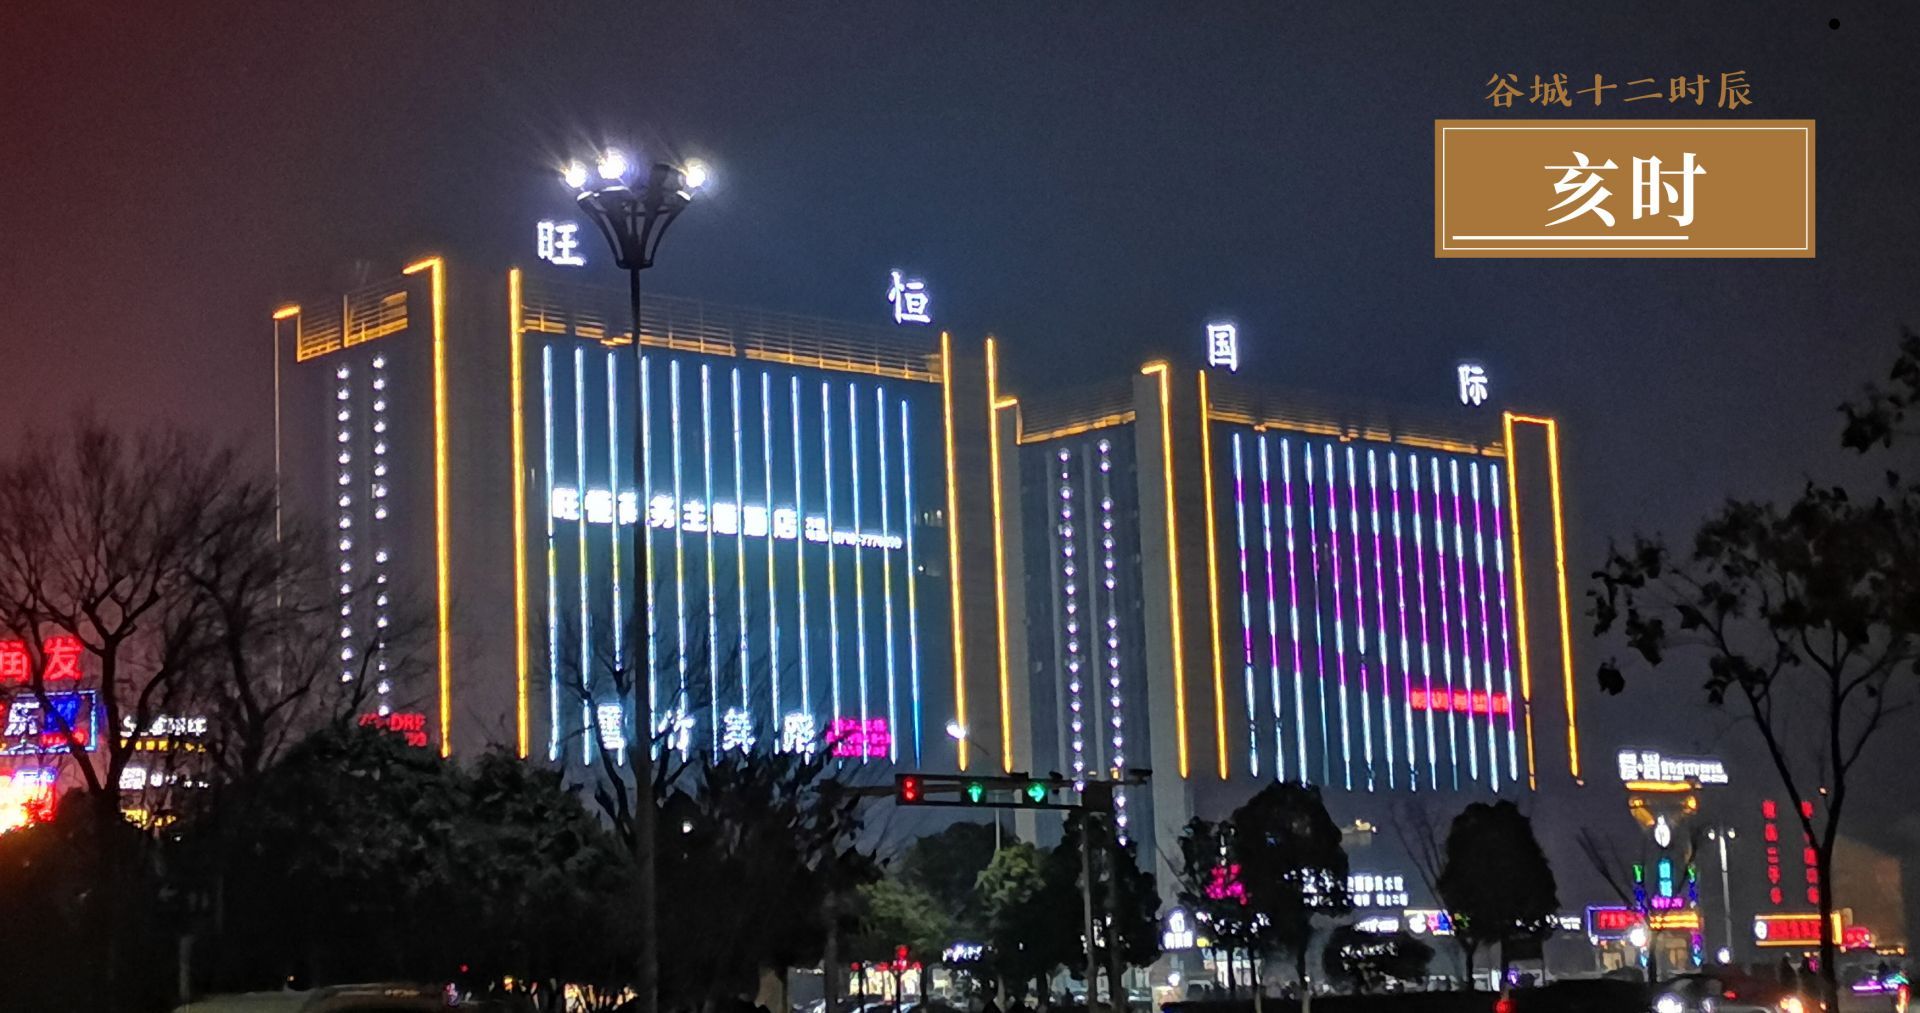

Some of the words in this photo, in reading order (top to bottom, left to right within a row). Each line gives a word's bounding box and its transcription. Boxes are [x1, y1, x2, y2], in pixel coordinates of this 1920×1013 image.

[536, 221, 585, 265] 旺
[888, 270, 931, 323] 恒
[1206, 323, 1238, 372] 国
[1457, 363, 1489, 406] 际
